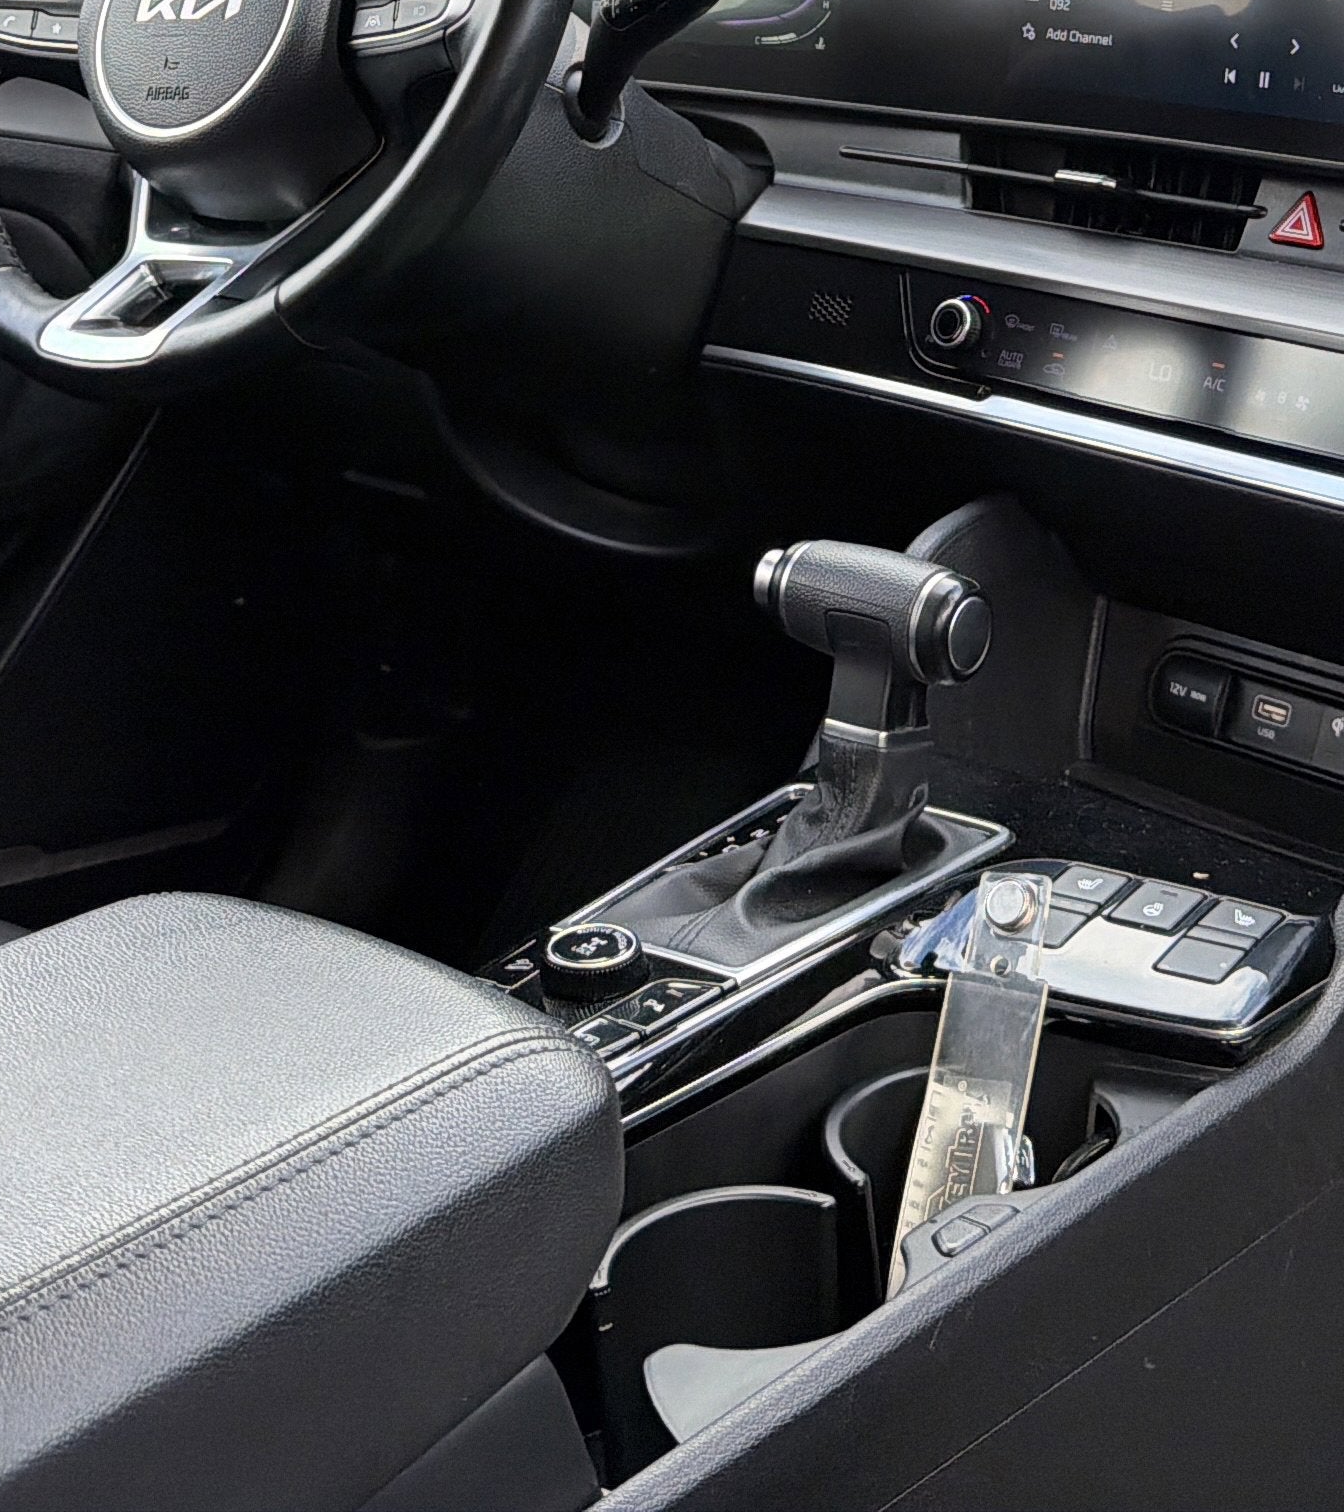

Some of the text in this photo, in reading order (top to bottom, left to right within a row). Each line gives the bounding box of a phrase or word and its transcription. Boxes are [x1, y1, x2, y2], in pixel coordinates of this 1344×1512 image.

[1045, 27, 1113, 47] Add Channel
[145, 84, 191, 103] AIRBAG
[998, 349, 1024, 362] AUTO
[1202, 375, 1227, 392] A/C
[1169, 680, 1189, 697] 12V
[1256, 725, 1276, 740] USB
